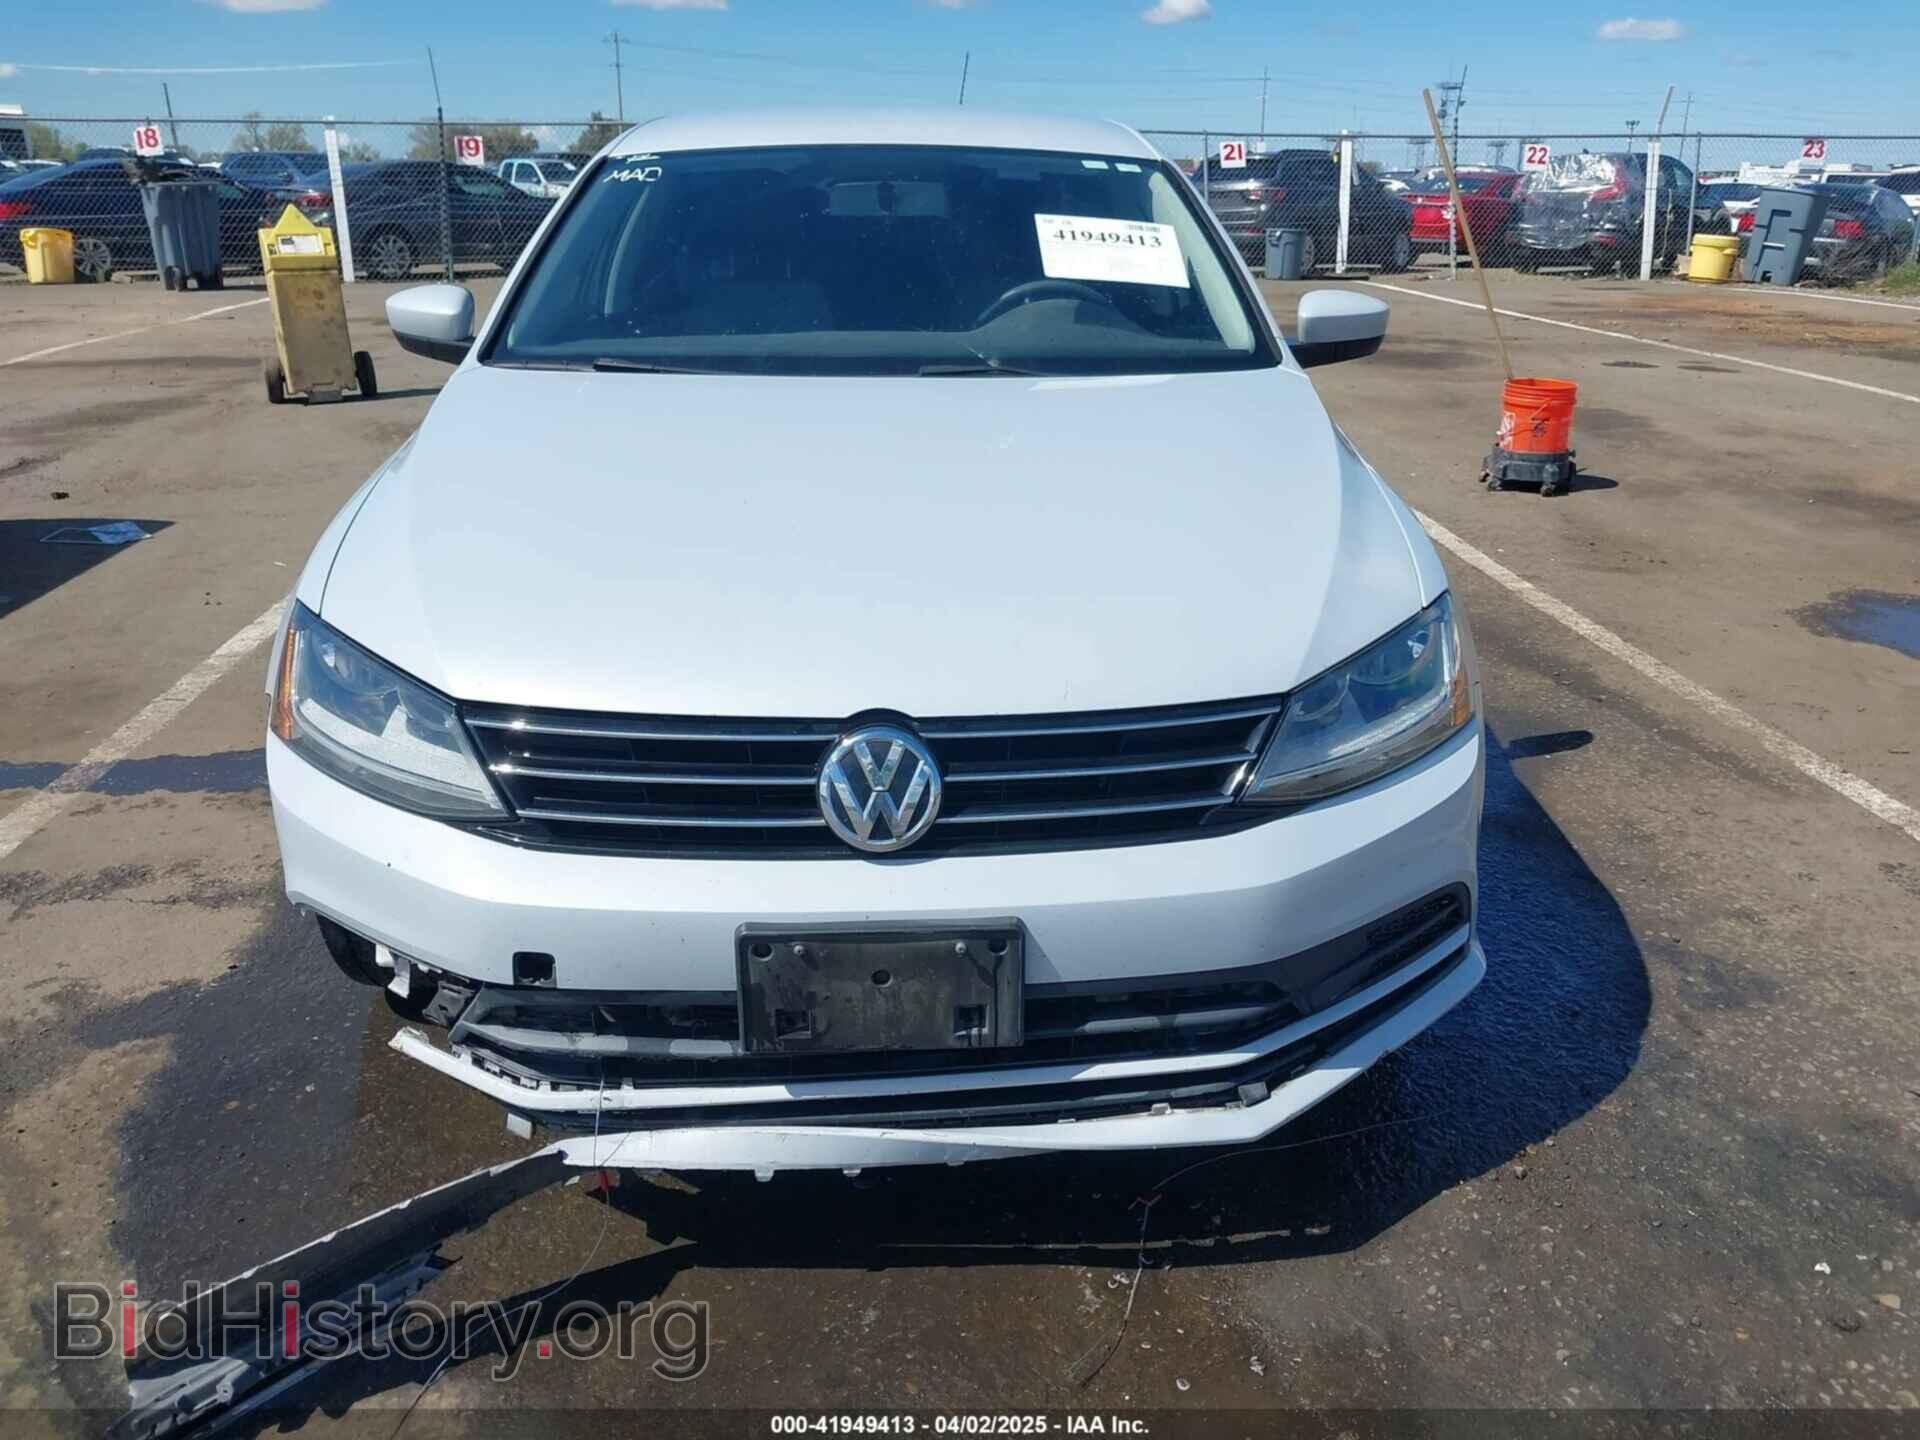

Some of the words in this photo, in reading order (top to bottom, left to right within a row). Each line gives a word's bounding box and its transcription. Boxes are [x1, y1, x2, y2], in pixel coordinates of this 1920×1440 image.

[136, 127, 158, 150] 18
[458, 128, 481, 157] 19
[1223, 143, 1243, 161] 21
[1527, 148, 1547, 165] 22
[1803, 140, 1824, 159] 23
[1054, 229, 1162, 248] 41949413
[825, 736, 937, 843] VW
